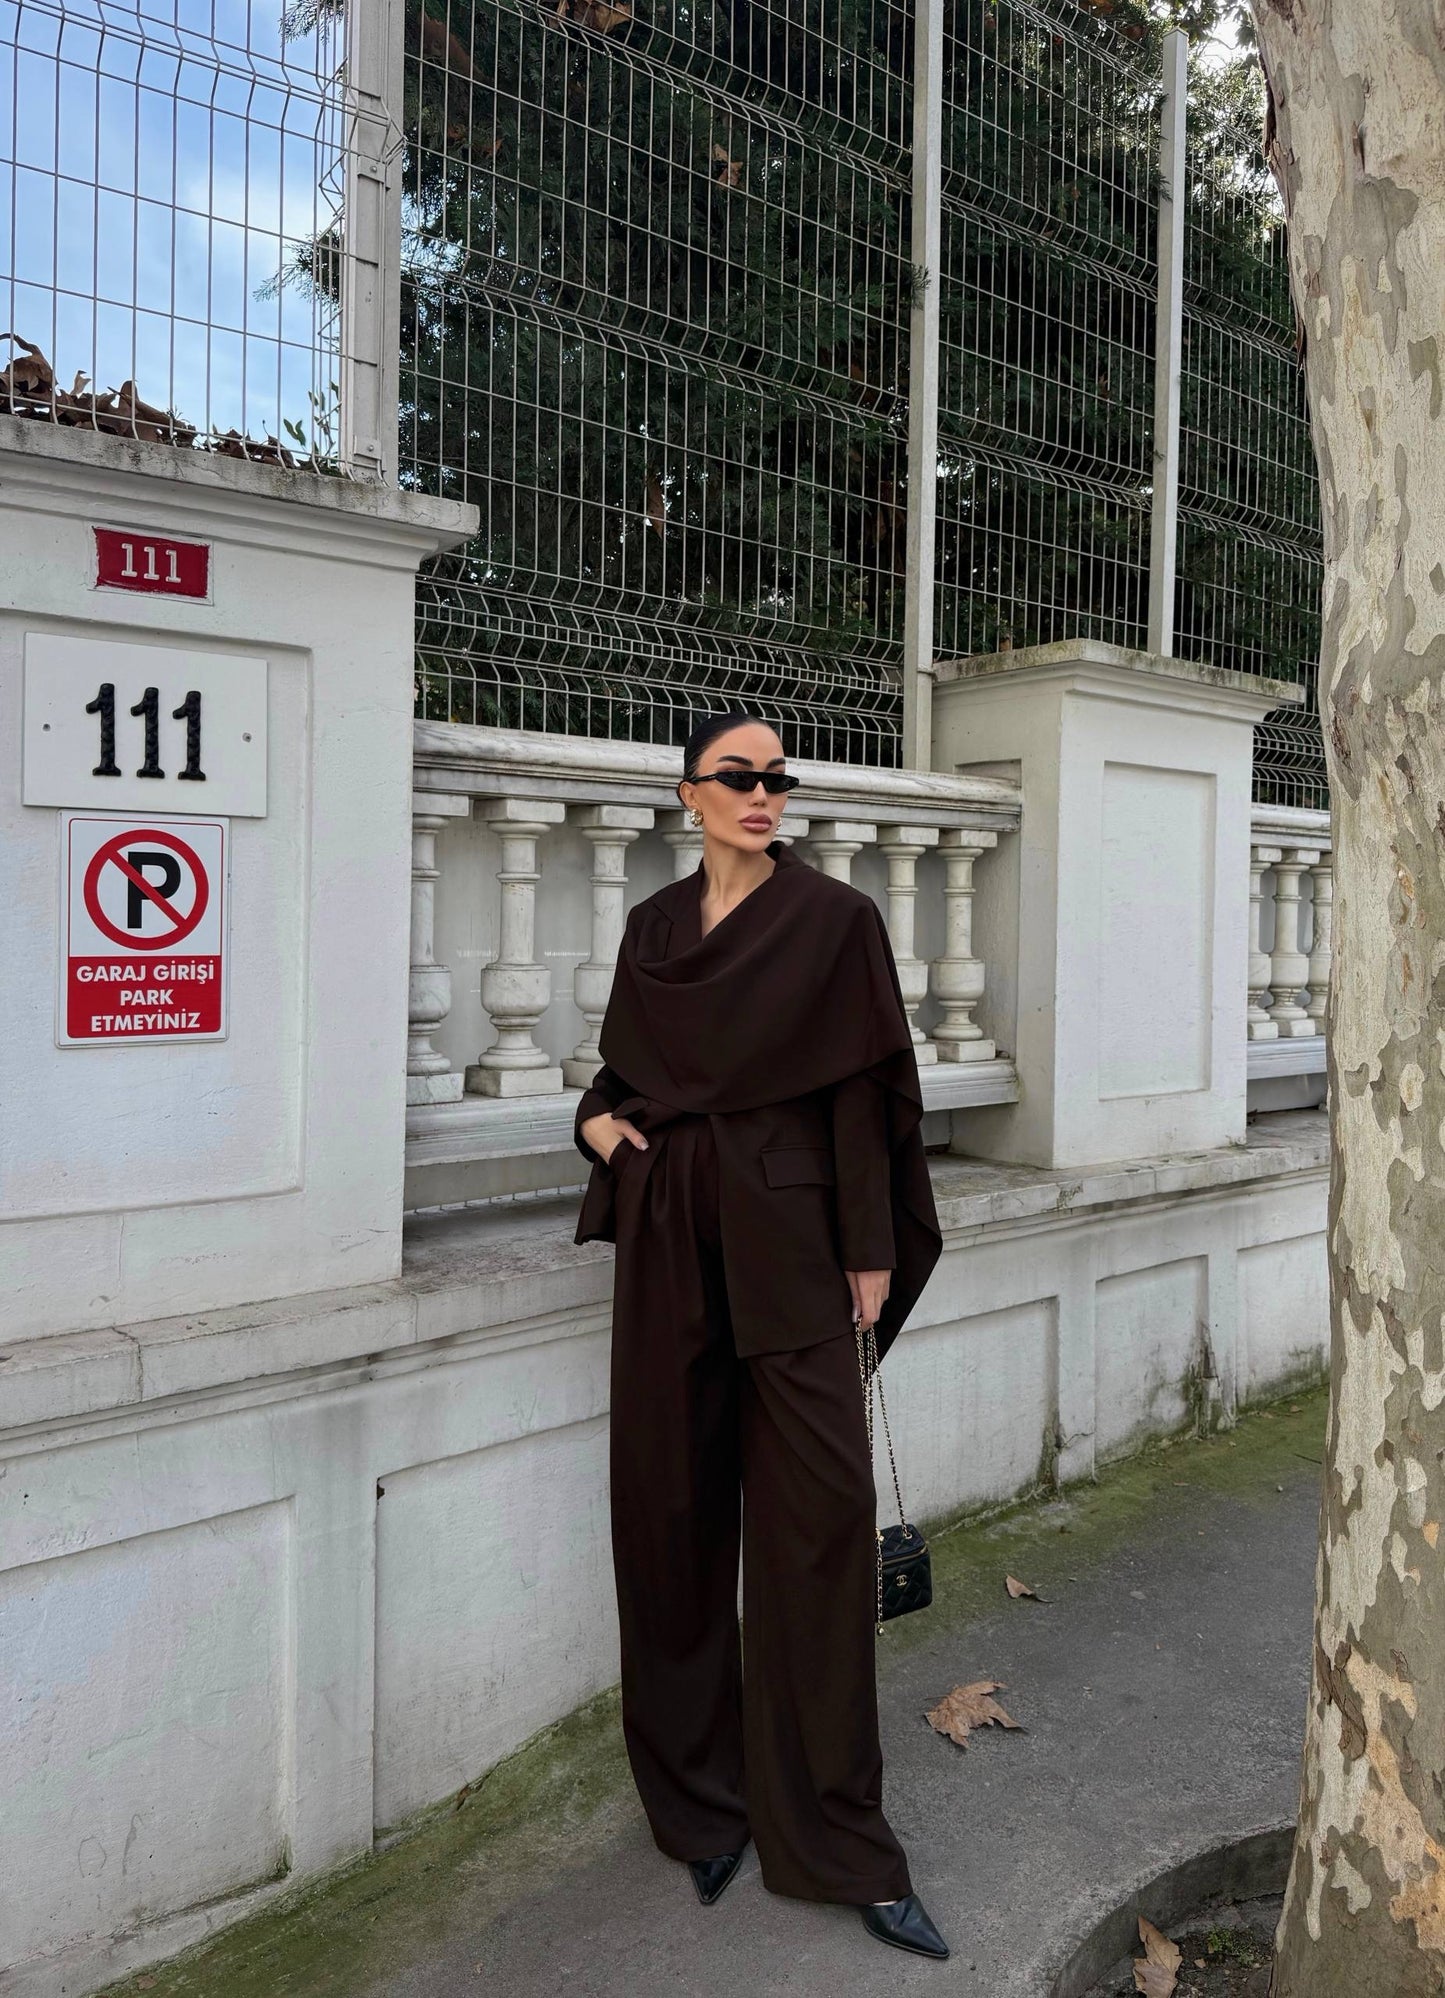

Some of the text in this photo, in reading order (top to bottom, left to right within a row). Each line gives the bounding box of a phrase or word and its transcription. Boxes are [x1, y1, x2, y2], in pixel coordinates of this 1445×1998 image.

[121, 543, 181, 583] 111
[86, 683, 206, 781] 111
[76, 959, 214, 984] GARAJ GİRİŞİ
[120, 989, 174, 1006] PARK
[91, 1008, 201, 1032] ETMEYİNİZ
